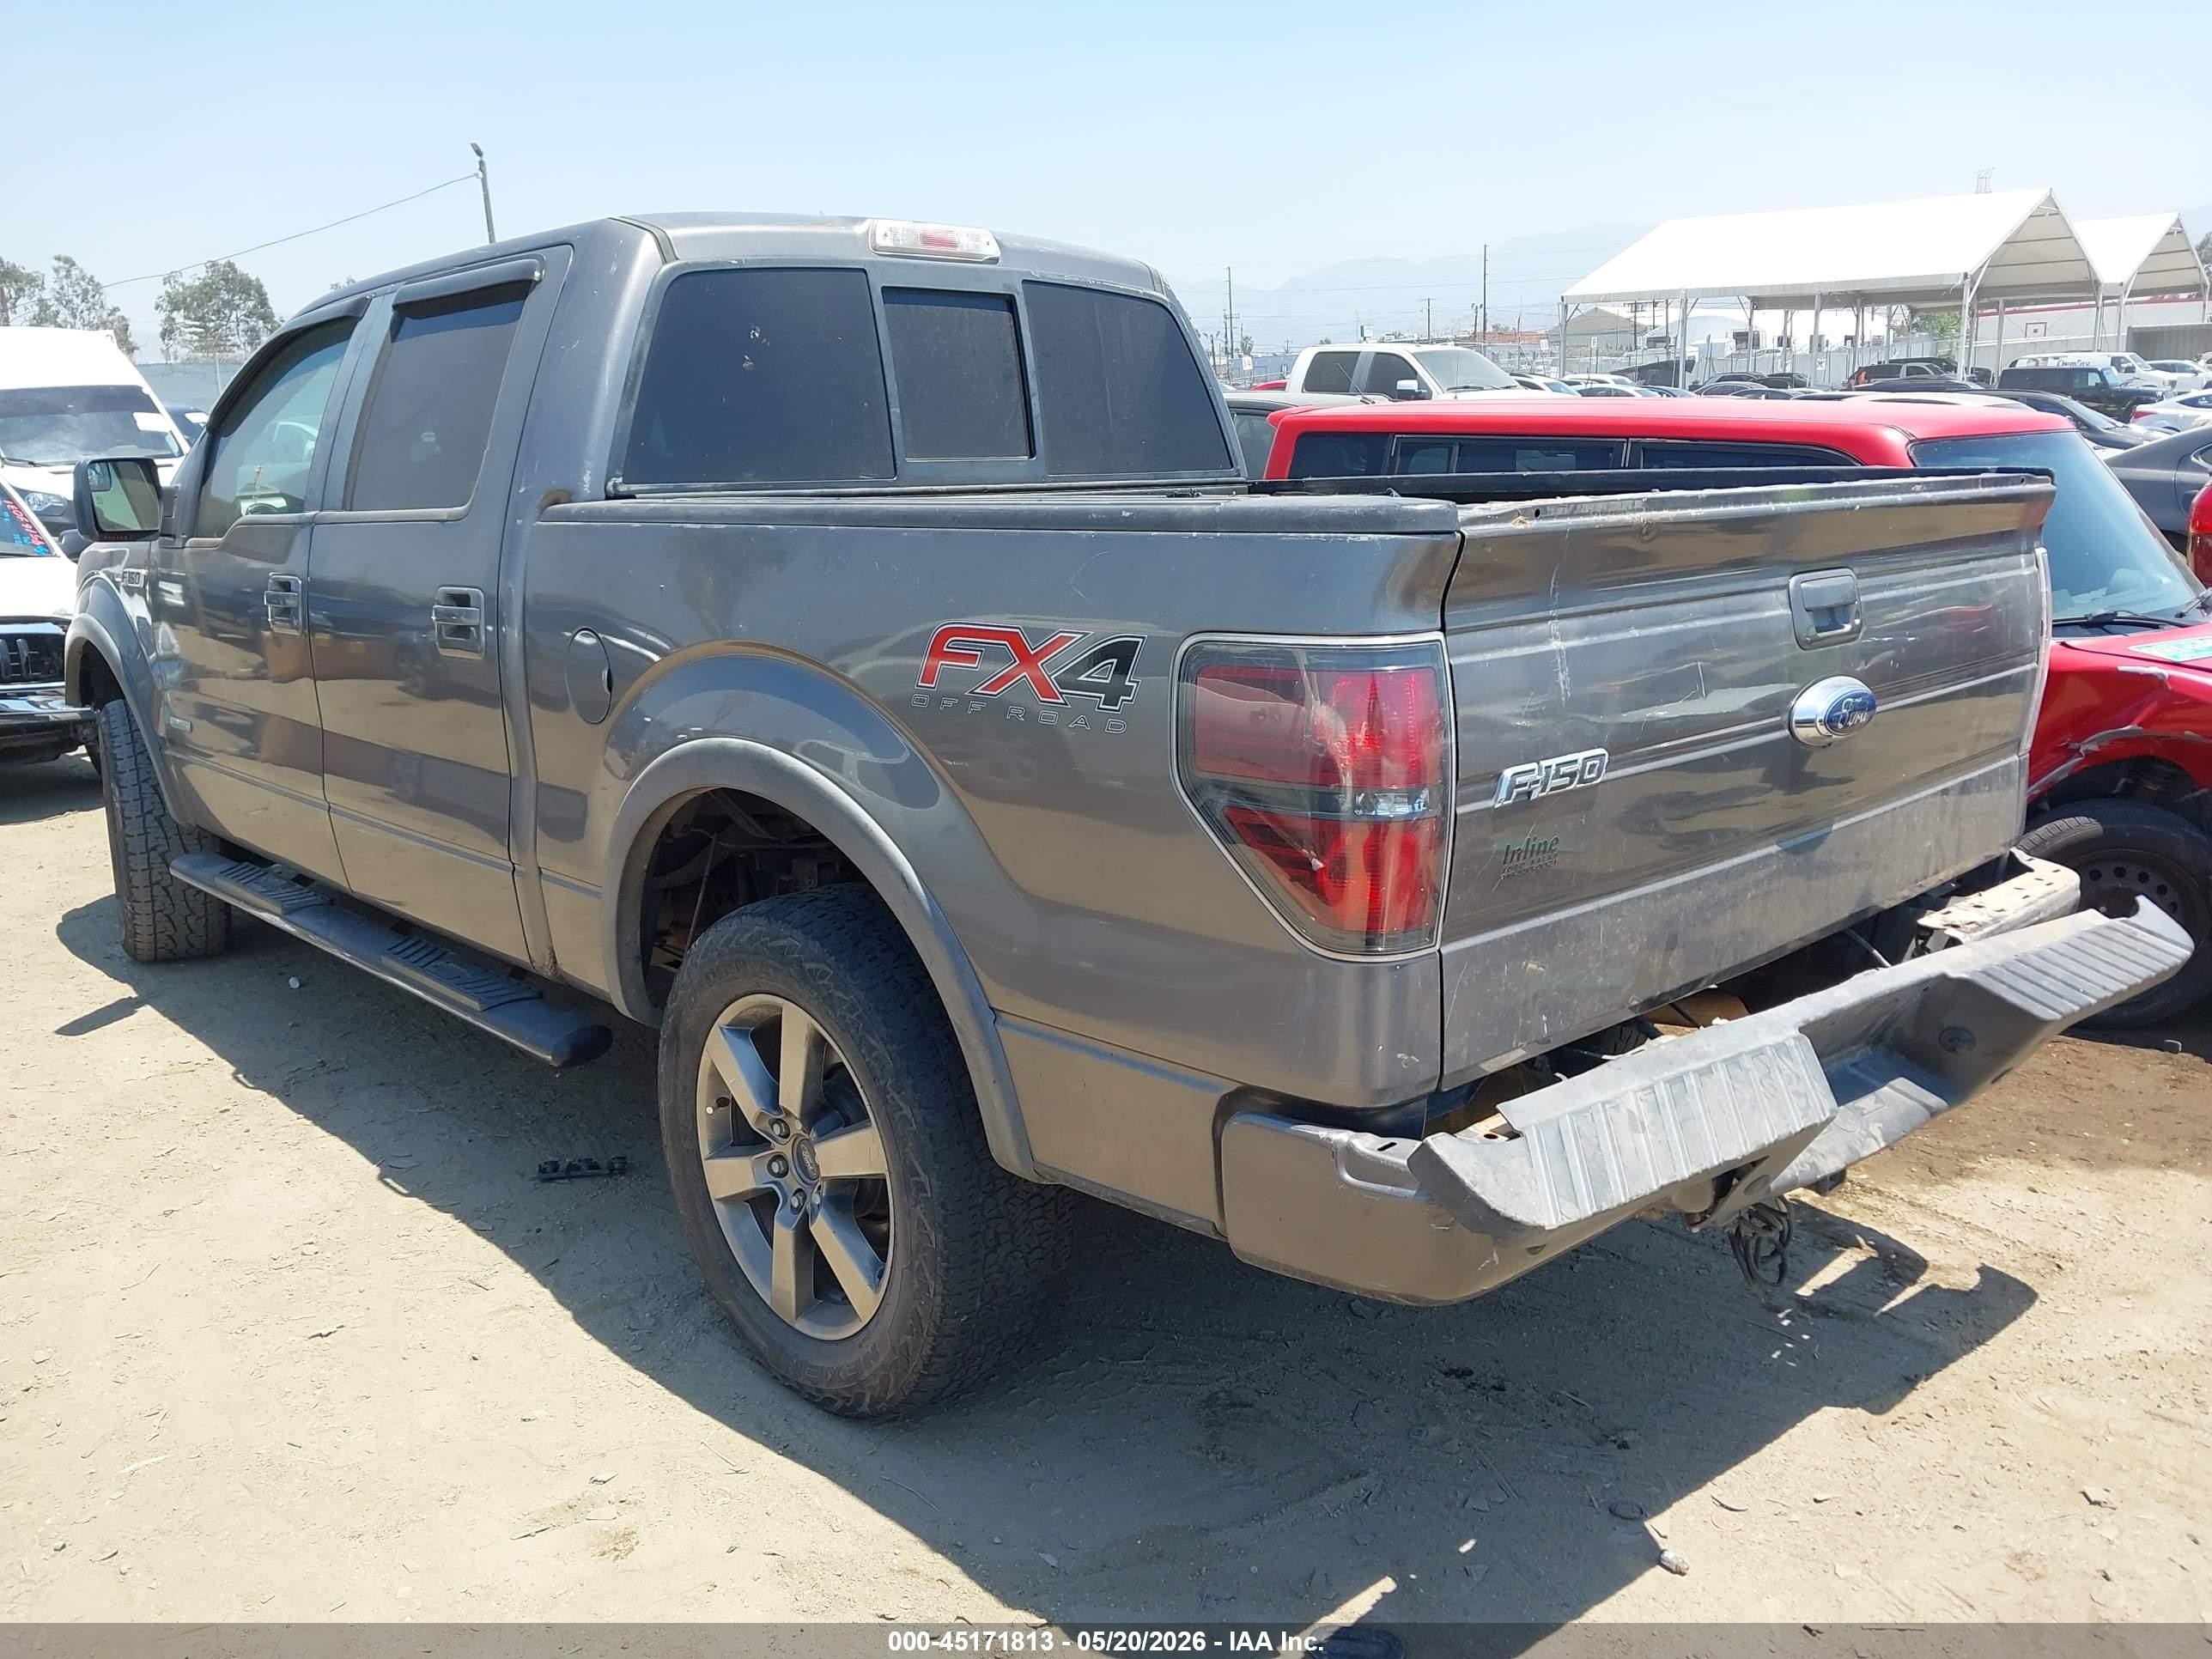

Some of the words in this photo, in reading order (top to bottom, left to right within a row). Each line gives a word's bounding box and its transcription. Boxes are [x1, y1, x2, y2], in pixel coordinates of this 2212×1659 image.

[915, 621, 1147, 714] FX4
[912, 693, 987, 714] OFF
[1006, 705, 1127, 733] ROAD
[1832, 696, 1869, 729] Ford
[1503, 836, 1559, 865] Inline
